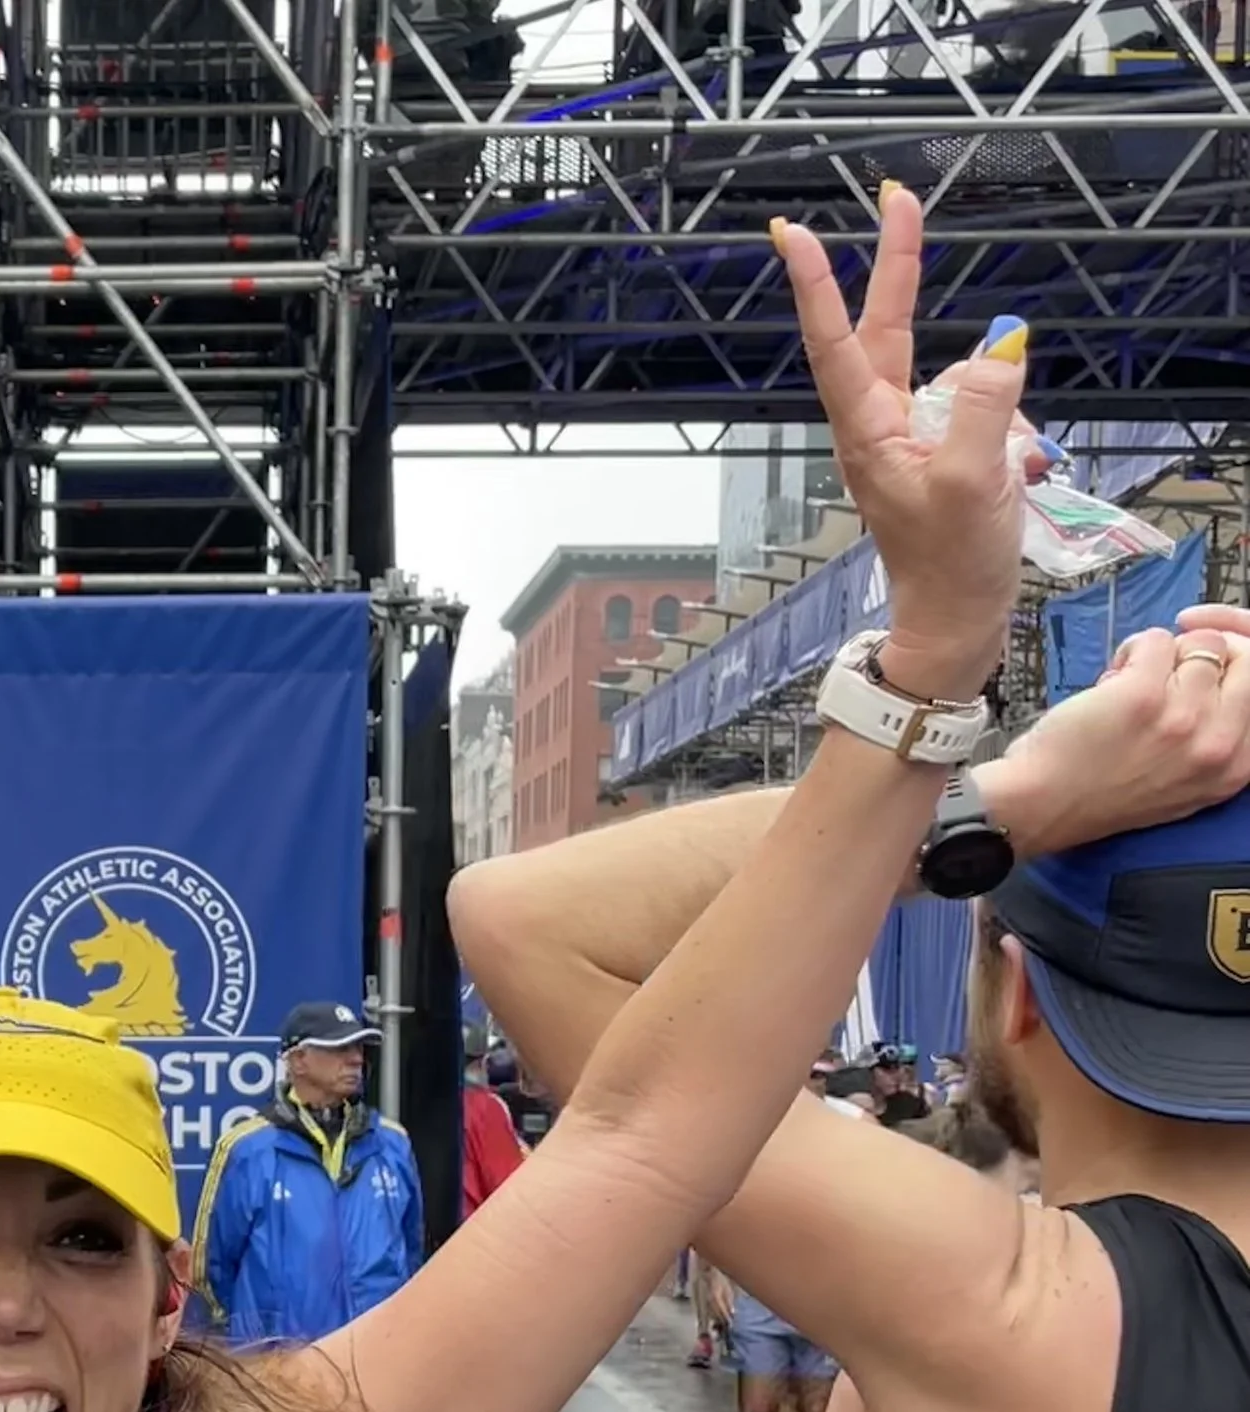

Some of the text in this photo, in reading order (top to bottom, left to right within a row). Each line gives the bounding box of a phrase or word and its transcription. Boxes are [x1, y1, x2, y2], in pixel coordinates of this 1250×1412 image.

[12, 858, 245, 1027] STON ATHLETIC ASSOCIATION
[147, 1051, 288, 1095] STO
